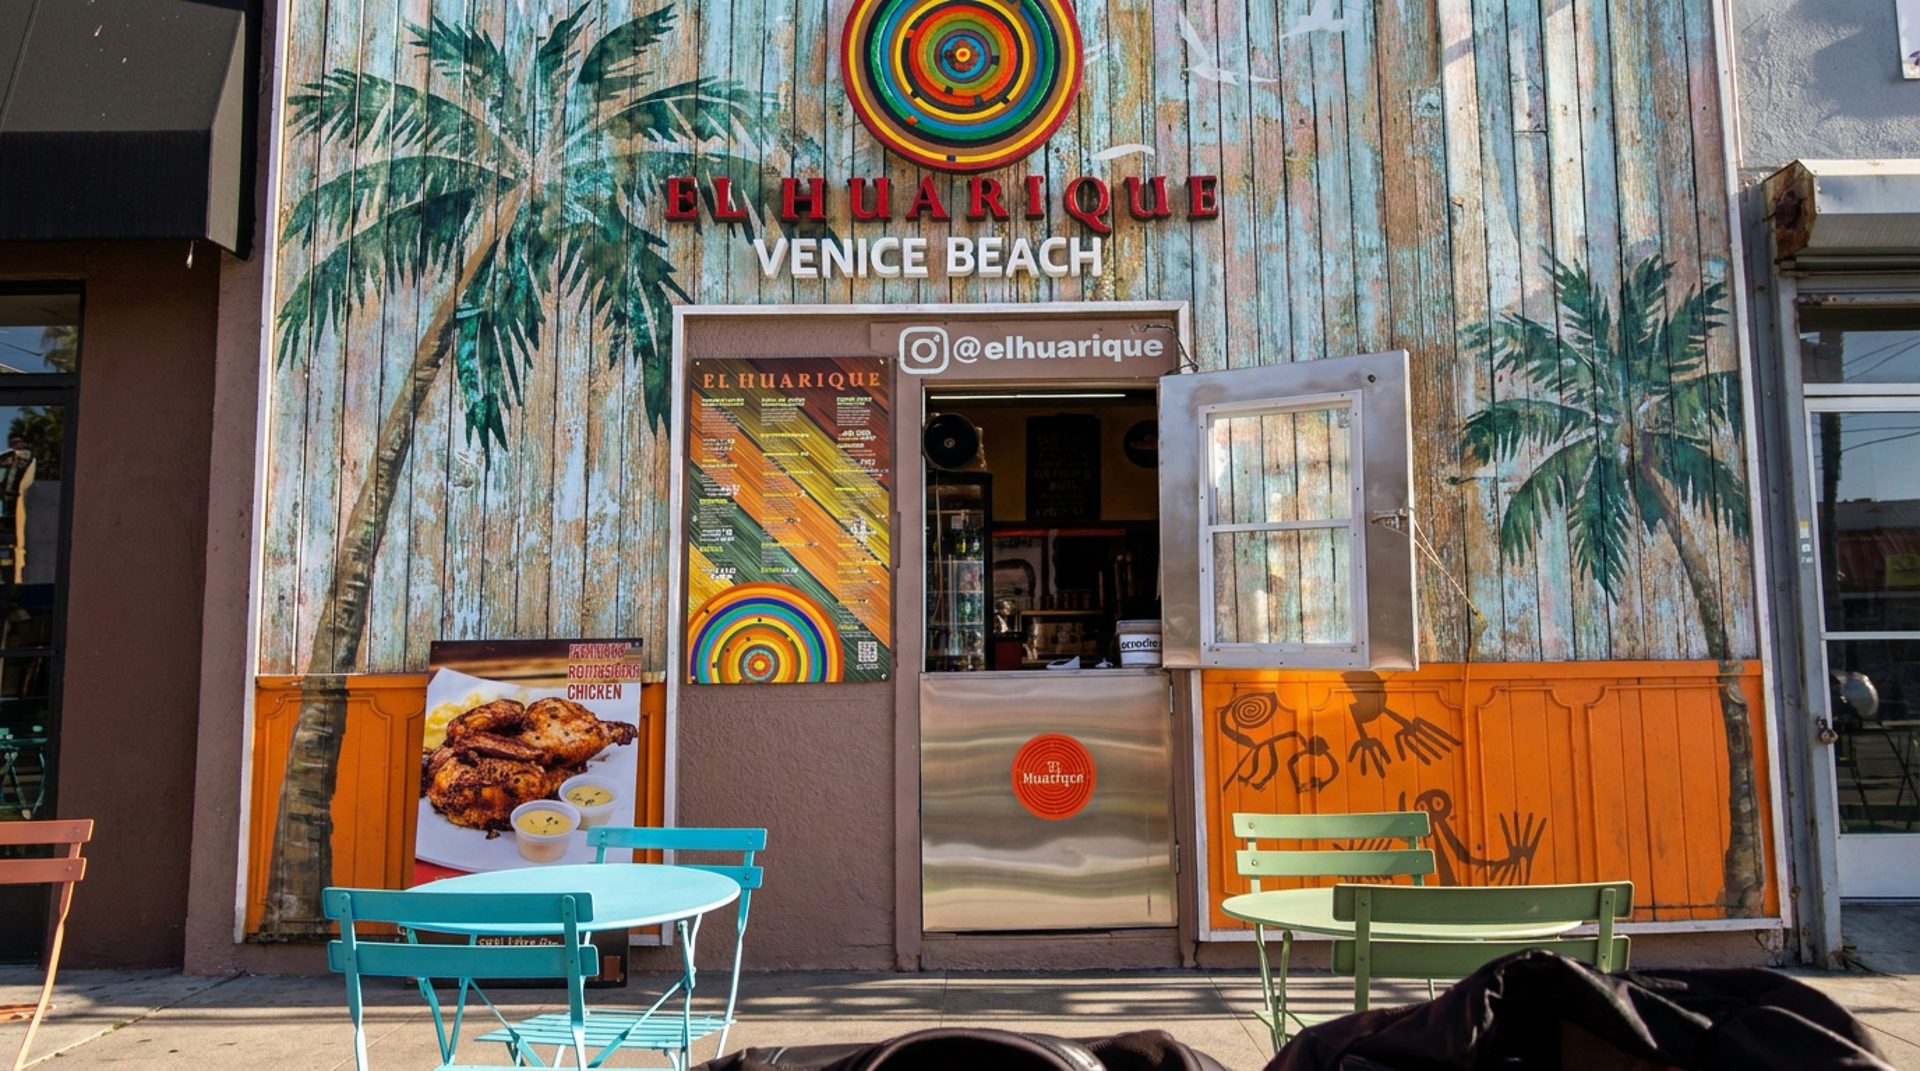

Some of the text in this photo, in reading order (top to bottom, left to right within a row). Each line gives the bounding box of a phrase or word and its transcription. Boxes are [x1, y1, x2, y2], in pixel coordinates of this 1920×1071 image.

[664, 174, 1220, 234] EL HUARIQUE
[753, 236, 1104, 279] VENICE BEACH
[953, 333, 1164, 364] @elhuarique
[703, 371, 881, 391] EL HUARIQUE
[567, 683, 622, 700] CHICKEN
